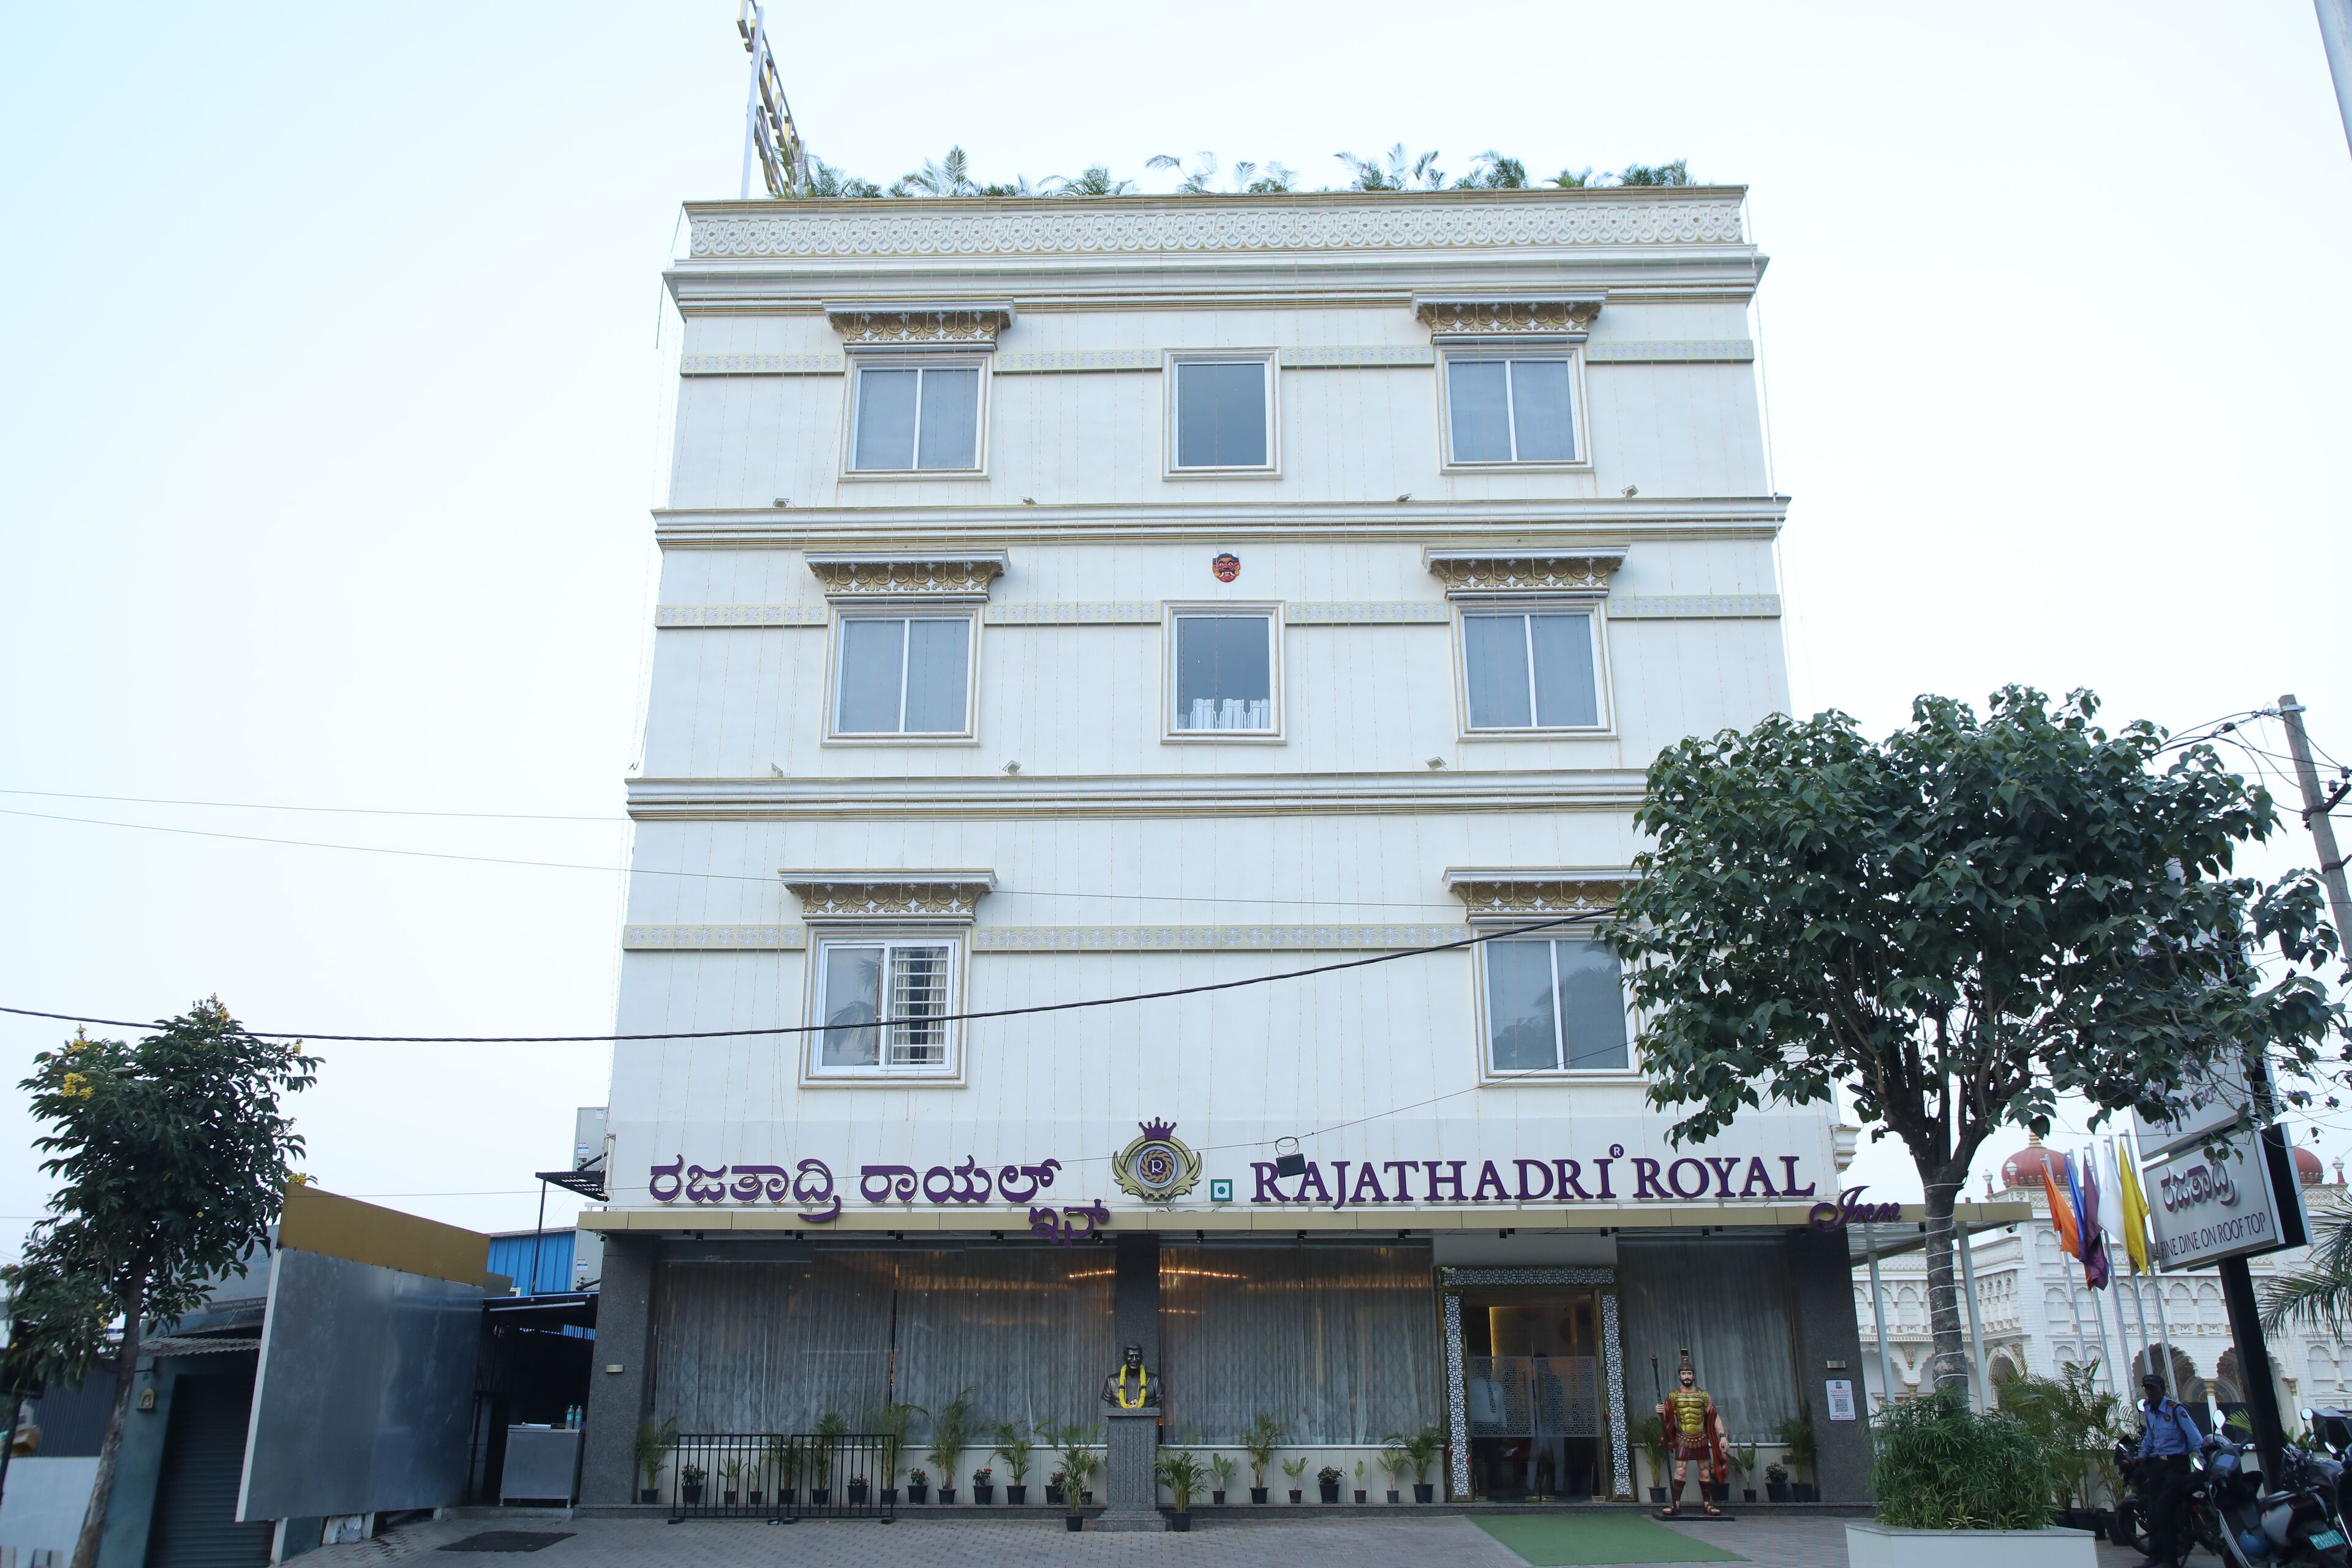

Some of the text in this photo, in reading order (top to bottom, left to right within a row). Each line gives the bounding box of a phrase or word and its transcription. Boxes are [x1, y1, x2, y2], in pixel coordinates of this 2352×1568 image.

[649, 1153, 1063, 1222] ರಜತಾದ್ರಿ ರಾಯಲ್
[1250, 1159, 1617, 1210] RAJATHADRI
[1630, 1156, 1816, 1199] ROYAL
[1809, 1185, 1902, 1232] Inn
[2160, 1212, 2266, 1259] FINE DINE ON ROOF TOP
